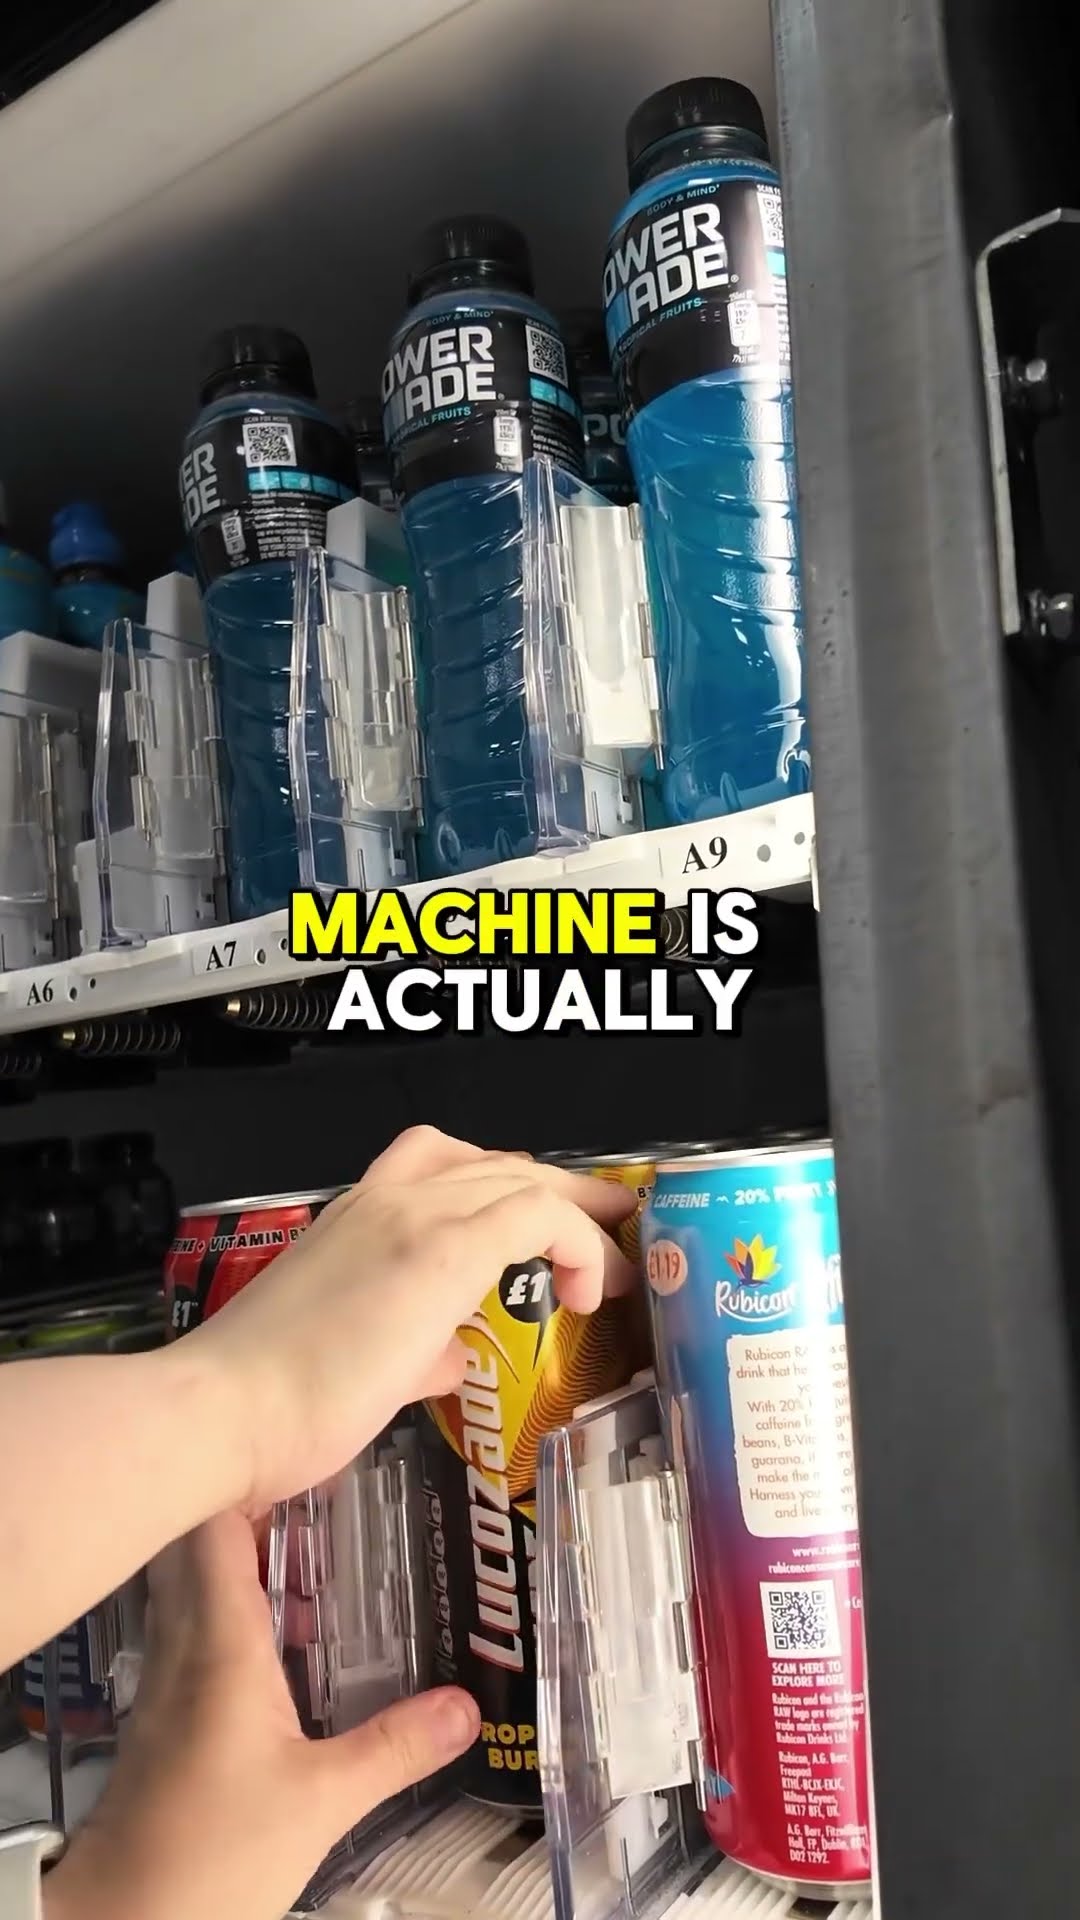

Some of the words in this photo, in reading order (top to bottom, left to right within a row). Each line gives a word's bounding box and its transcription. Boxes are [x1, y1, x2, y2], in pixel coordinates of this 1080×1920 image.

[660, 298, 702, 322] FRUITS
[432, 407, 472, 423] FRUITS
[682, 837, 729, 874] A9
[206, 941, 237, 972] A7
[27, 978, 54, 1006] A6
[654, 1193, 711, 1209] CAFFEINE
[734, 1187, 770, 1206] 20%
[209, 1229, 284, 1251] VITAMIN
[715, 1280, 799, 1322] Rubicon
[745, 1347, 791, 1361] Rubicon
[736, 1365, 765, 1379] drink
[768, 1364, 790, 1377] that
[747, 1400, 775, 1413] With
[755, 1416, 801, 1431] caffeine
[742, 1435, 780, 1449] beans,
[757, 1470, 788, 1483] make
[792, 1469, 809, 1482] the
[750, 1488, 796, 1501] Harness
[775, 1504, 797, 1518] and
[772, 1662, 797, 1674] SCAN
[799, 1662, 825, 1674] HERE
[827, 1661, 842, 1673] TO
[772, 1675, 814, 1687] EXPLORE
[816, 1674, 845, 1687] MORE
